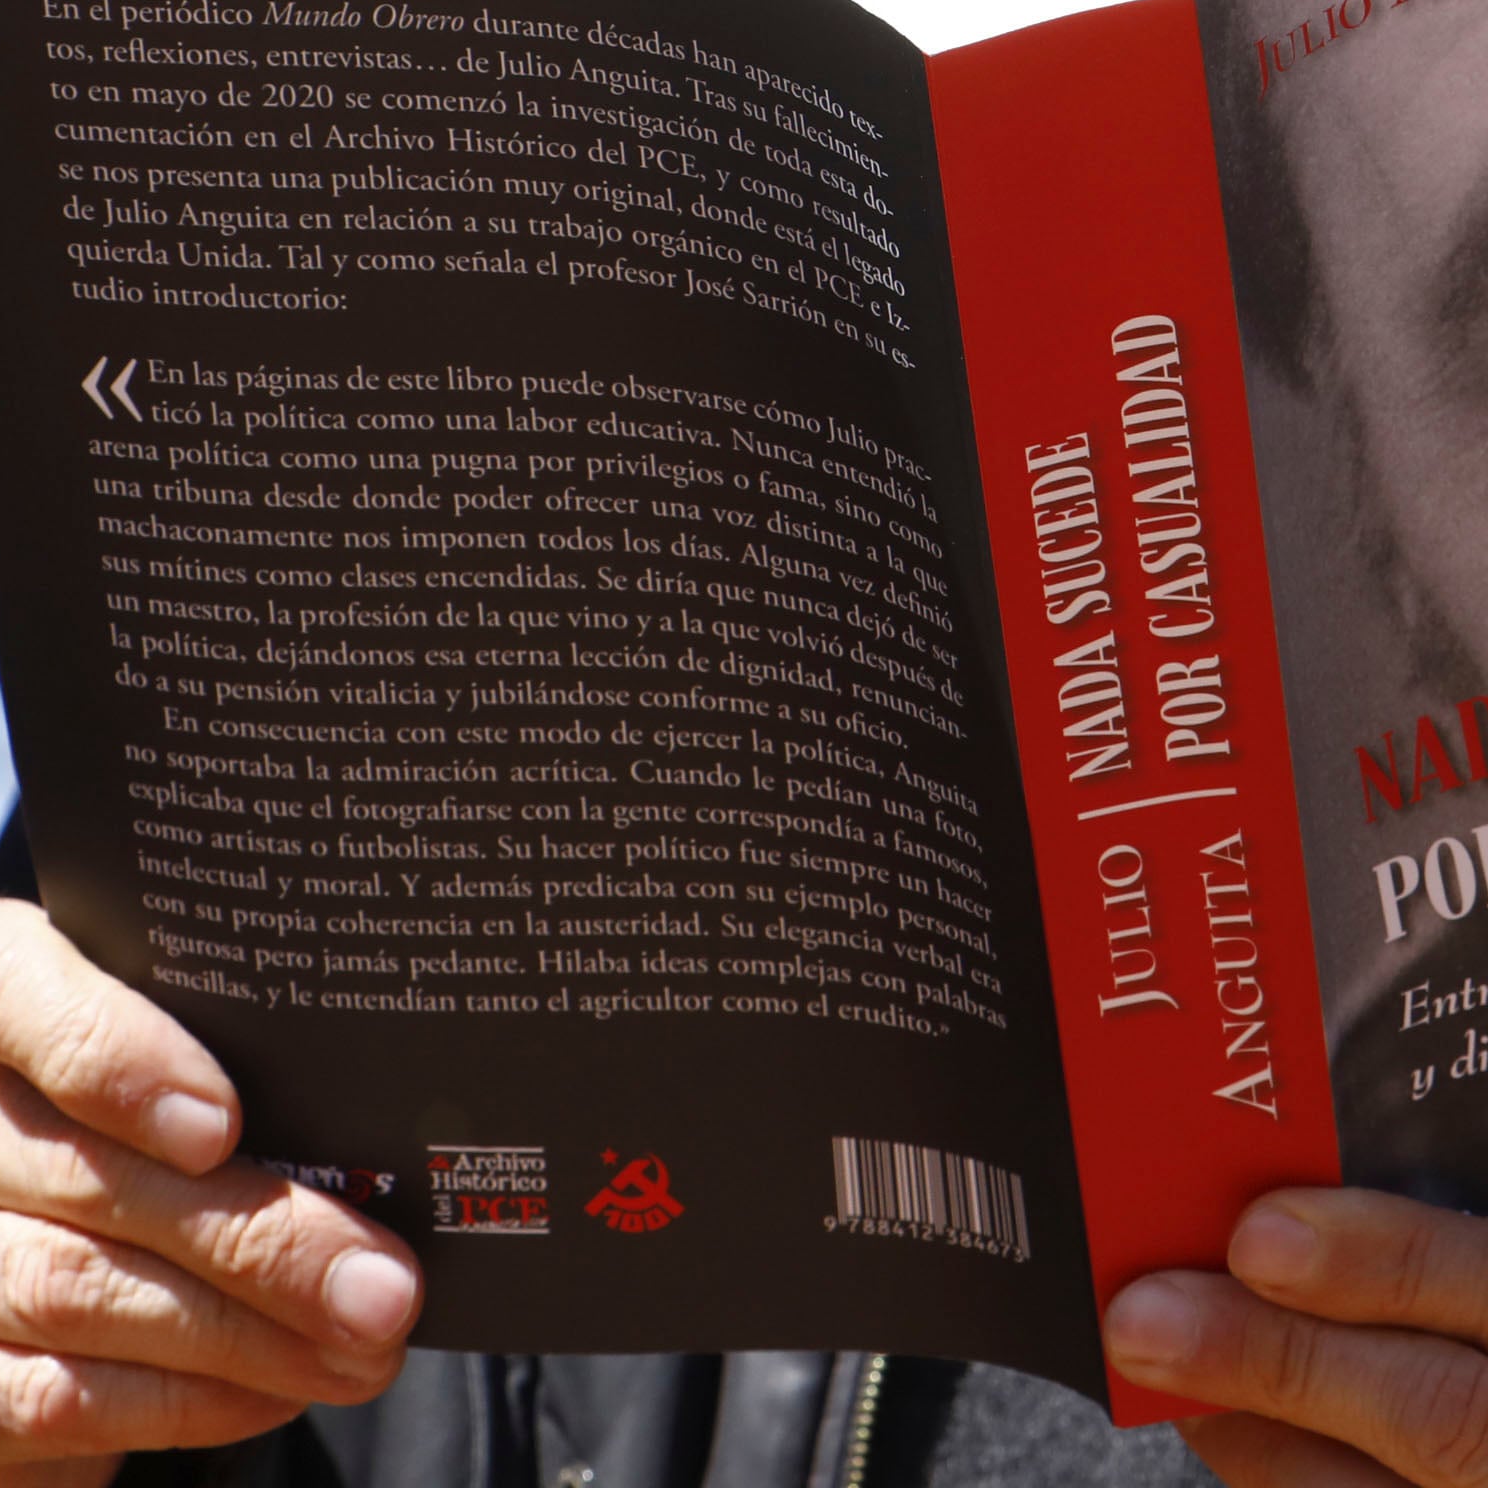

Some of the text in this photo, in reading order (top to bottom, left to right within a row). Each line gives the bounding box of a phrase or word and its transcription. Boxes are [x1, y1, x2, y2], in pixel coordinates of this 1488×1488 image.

[45, 41, 94, 64] tos,
[103, 37, 258, 70] reflexiones,
[456, 47, 489, 74] de
[495, 50, 562, 81] Julio
[568, 57, 681, 99] Anguita.
[684, 76, 737, 113] Tras
[742, 100, 769, 123] su
[773, 103, 889, 179] fallecimien-
[261, 0, 362, 28] Mundo
[372, 3, 465, 32] Obrero
[472, 7, 580, 42] durante
[586, 19, 686, 61] décadas
[692, 39, 738, 75] han
[744, 64, 845, 120] aparecido
[848, 109, 884, 141] tex-
[49, 80, 895, 216] to en mayo de 2020 se comenzó la investigación de toda esta do-
[54, 122, 900, 259] cumentación en el Archivo Histórico del PCE, y como resultado
[58, 163, 906, 297] se nos presenta una publicación muy original, donde está el legado
[62, 194, 911, 332] de Julio Anguita en relación a su trabajo orgánico en el PCE e Iz-
[71, 275, 348, 310] tudio introductorio:
[66, 238, 916, 369] quierda Unida. Tal y como señala el profesor José Sarrión en su es-
[147, 358, 932, 481] En las páginas de este libro puede observarse cómo Julio prac-
[151, 400, 939, 525] ticó la política como una labor educativa. Nunca entendió la
[1112, 313, 1231, 762] POR CASUALIDAD
[1025, 431, 1133, 783] NADA SUCEDE
[114, 661, 909, 750] do a su pensión vitalicia y jubilándose conforme a su oficio.
[151, 964, 259, 1003] sencillas,
[266, 986, 282, 1010] y
[289, 980, 313, 1007] le
[320, 986, 457, 1012] entendían
[465, 994, 539, 1013] tanto
[546, 986, 569, 1013] el
[579, 986, 713, 1020] agricultor
[721, 996, 799, 1014] como
[806, 993, 829, 1017] el
[1098, 844, 1179, 1017] JULIO
[1199, 827, 1278, 1120] ANGUITA
[1410, 1065, 1436, 1100] y
[431, 1169, 548, 1192] Histórico
[454, 1152, 546, 1172] Archivo
[456, 1195, 550, 1226] PCE
[823, 1215, 837, 1233] 9
